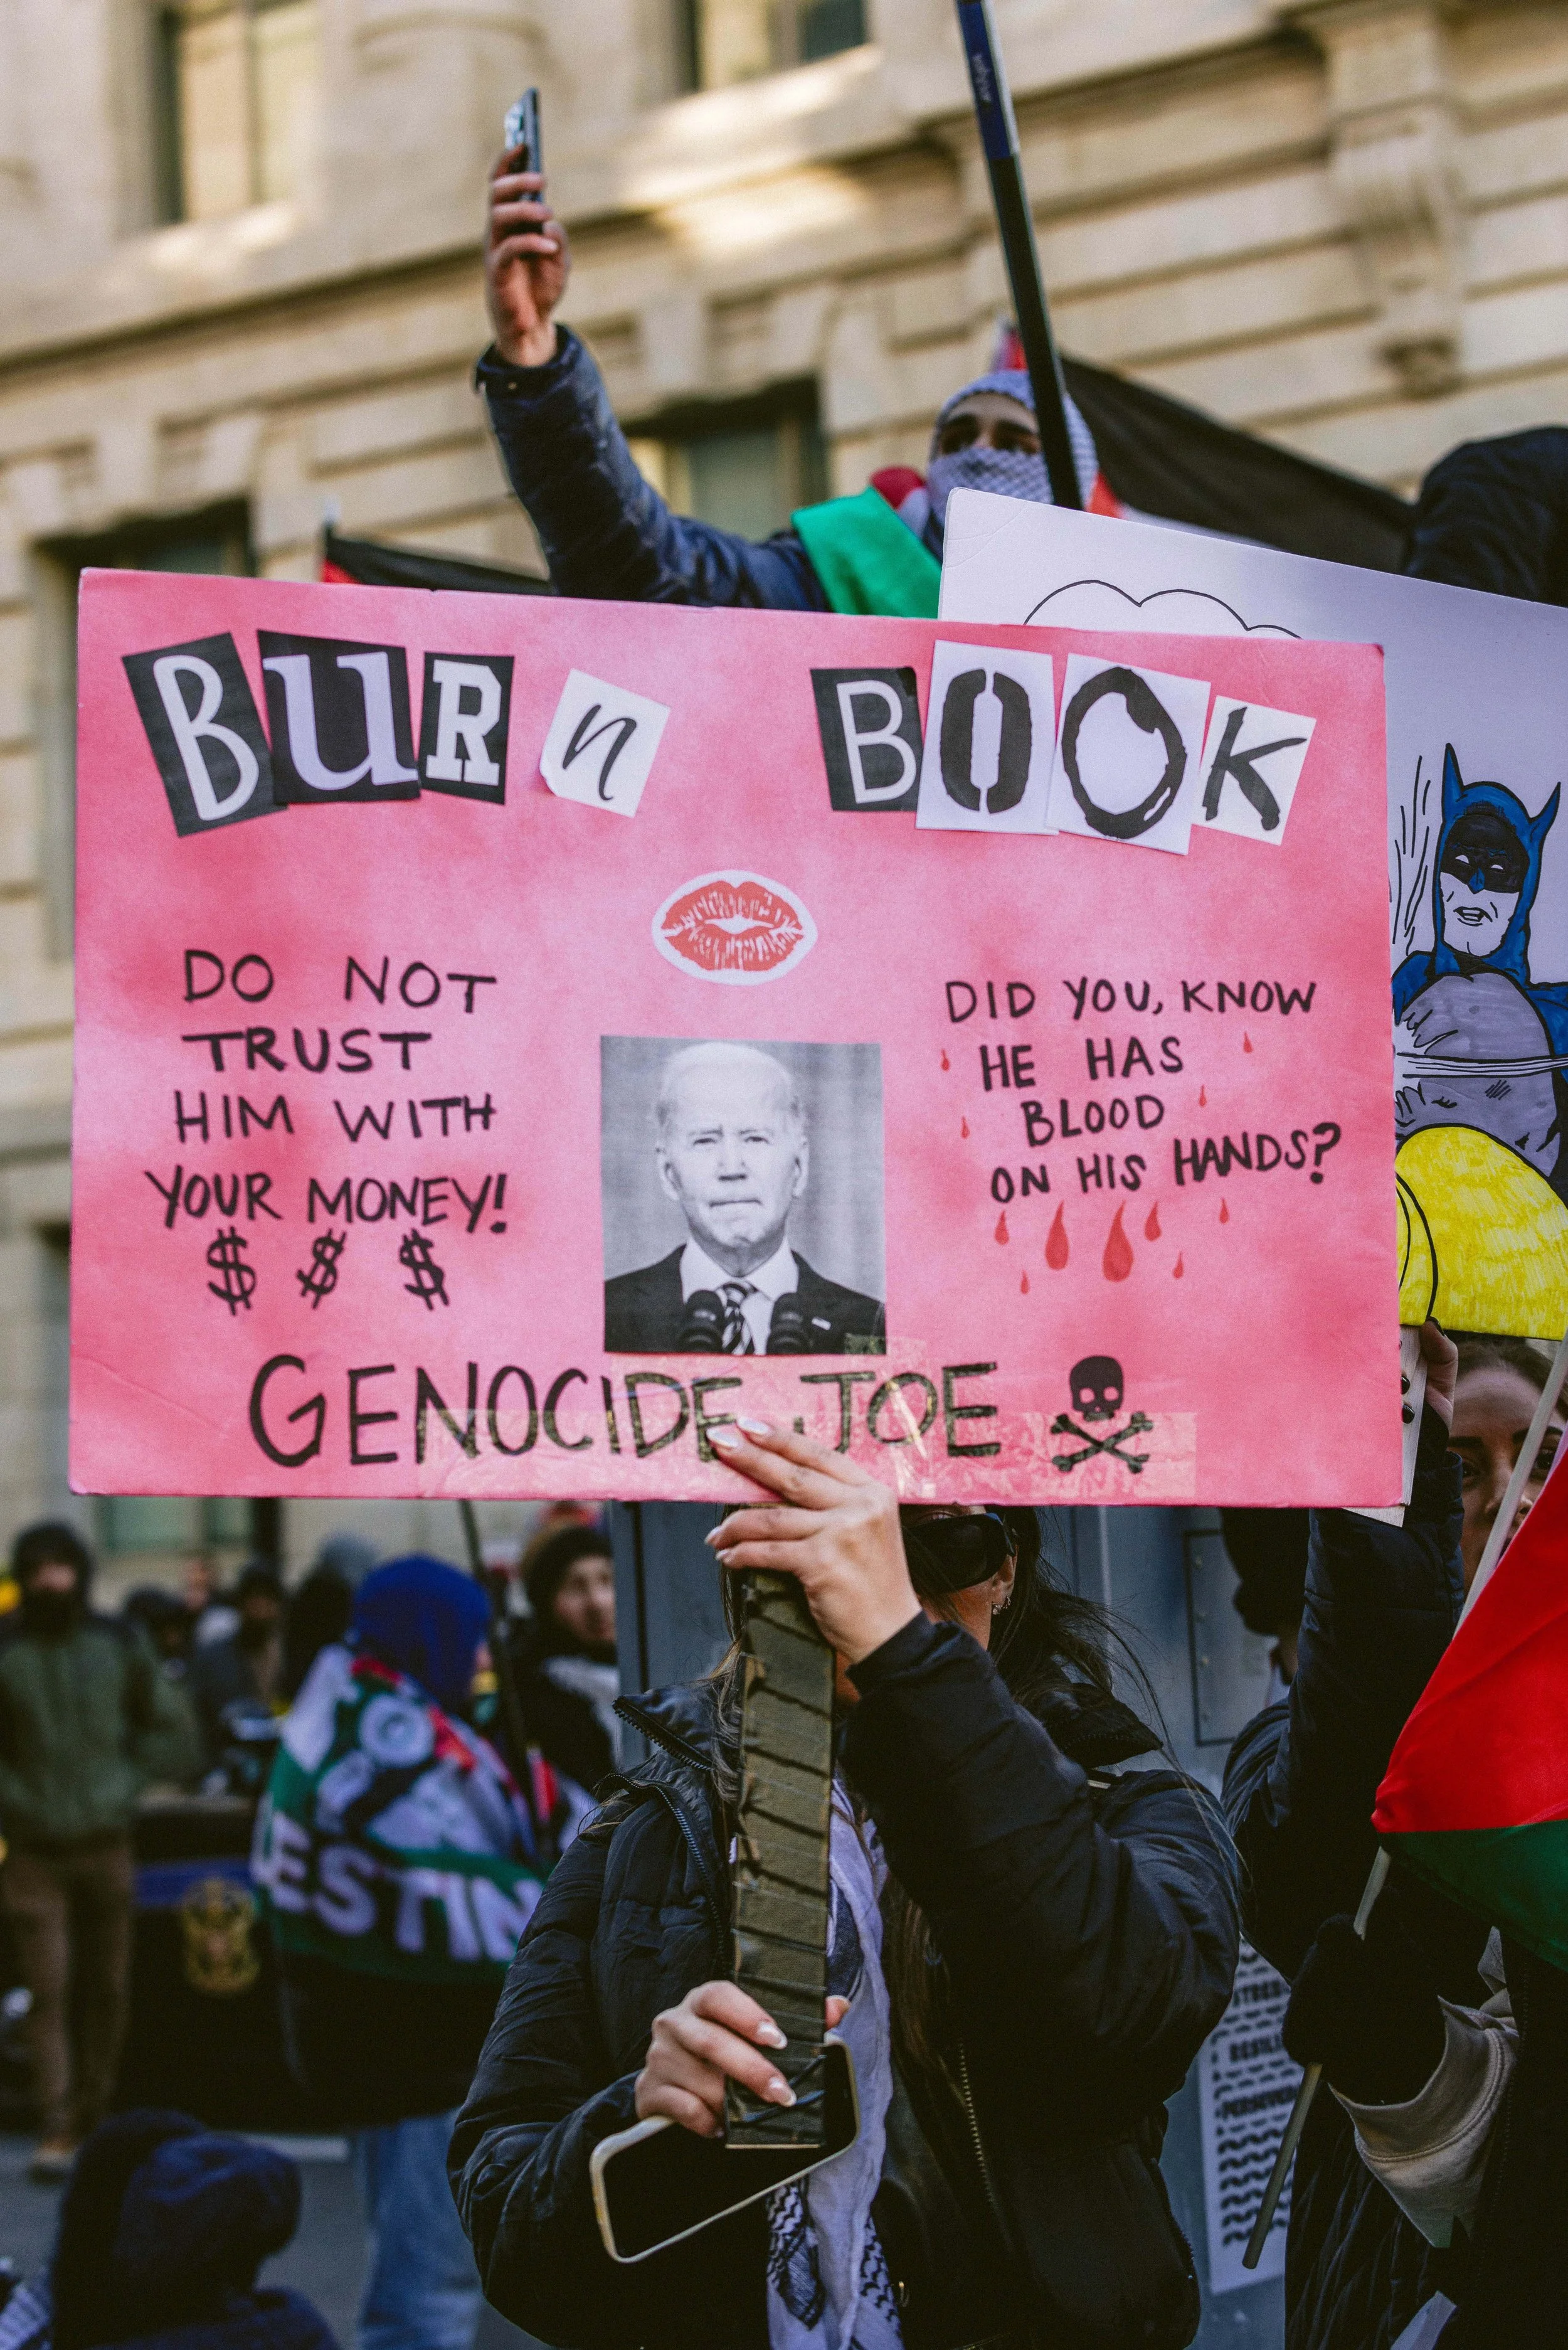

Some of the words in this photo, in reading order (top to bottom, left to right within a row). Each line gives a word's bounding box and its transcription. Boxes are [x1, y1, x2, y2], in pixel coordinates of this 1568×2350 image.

[835, 666, 1307, 839] BOOK
[184, 949, 275, 1003] DO
[344, 957, 497, 1014] NOT
[945, 981, 1036, 1024] DID
[1064, 977, 1163, 1021] YOU,
[1181, 981, 1316, 1016] KNOW
[182, 1026, 432, 1073] TRUST
[979, 1045, 1036, 1092] HE
[1086, 1036, 1184, 1081] HAS
[174, 1090, 294, 1143] HIM
[334, 1093, 495, 1142] WITH
[1020, 1094, 1165, 1147] BLOOD
[990, 1165, 1050, 1204] ON
[1077, 1154, 1146, 1193] HIS
[1173, 1122, 1342, 1186] HANDS?
[145, 1165, 281, 1229] YOUR
[307, 1173, 507, 1233] MONEY!
[248, 1354, 743, 1468] GENOCIDE
[793, 1361, 1002, 1458] JOE
